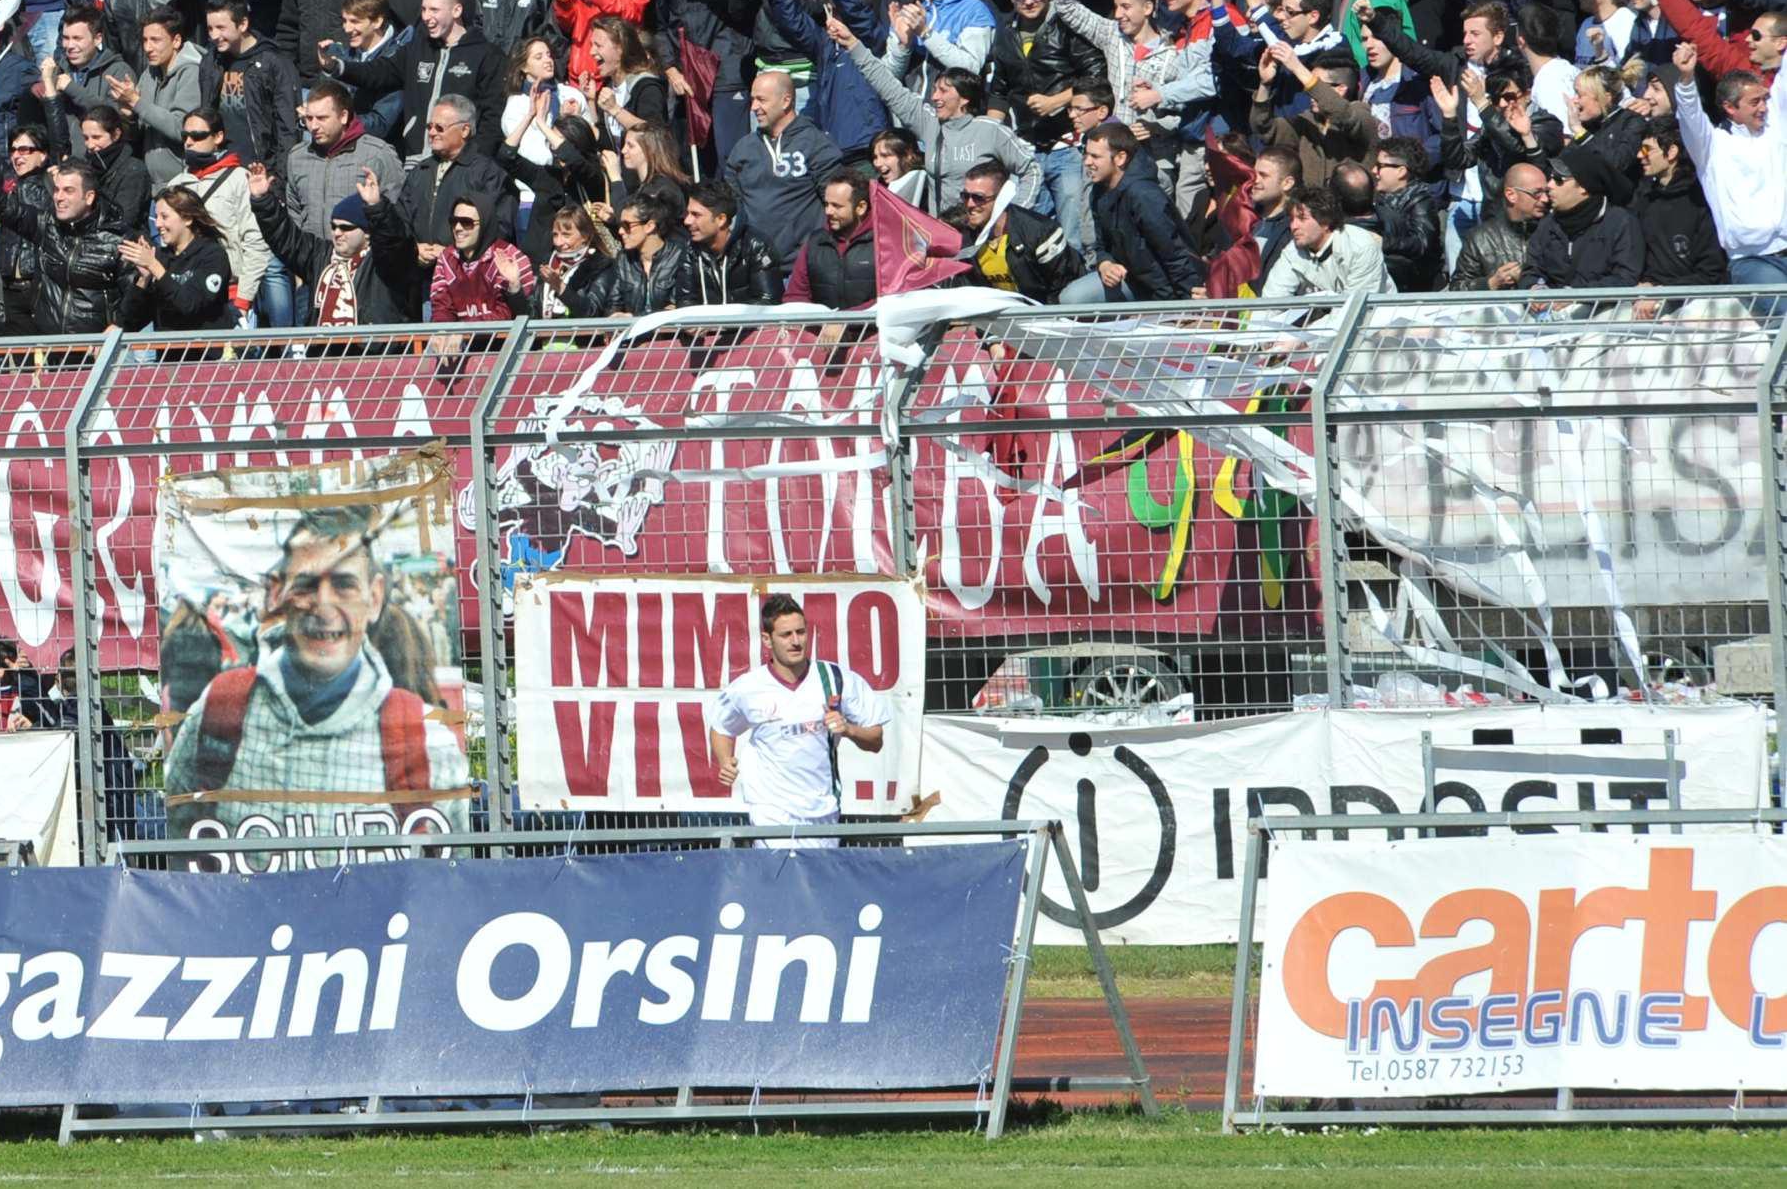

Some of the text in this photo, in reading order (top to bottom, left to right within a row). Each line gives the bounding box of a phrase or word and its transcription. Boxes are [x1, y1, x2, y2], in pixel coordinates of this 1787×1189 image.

[456, 902, 884, 1032] Orsini
[1345, 989, 1685, 1054] INSEGNE
[1449, 1053, 1525, 1078] 732153
